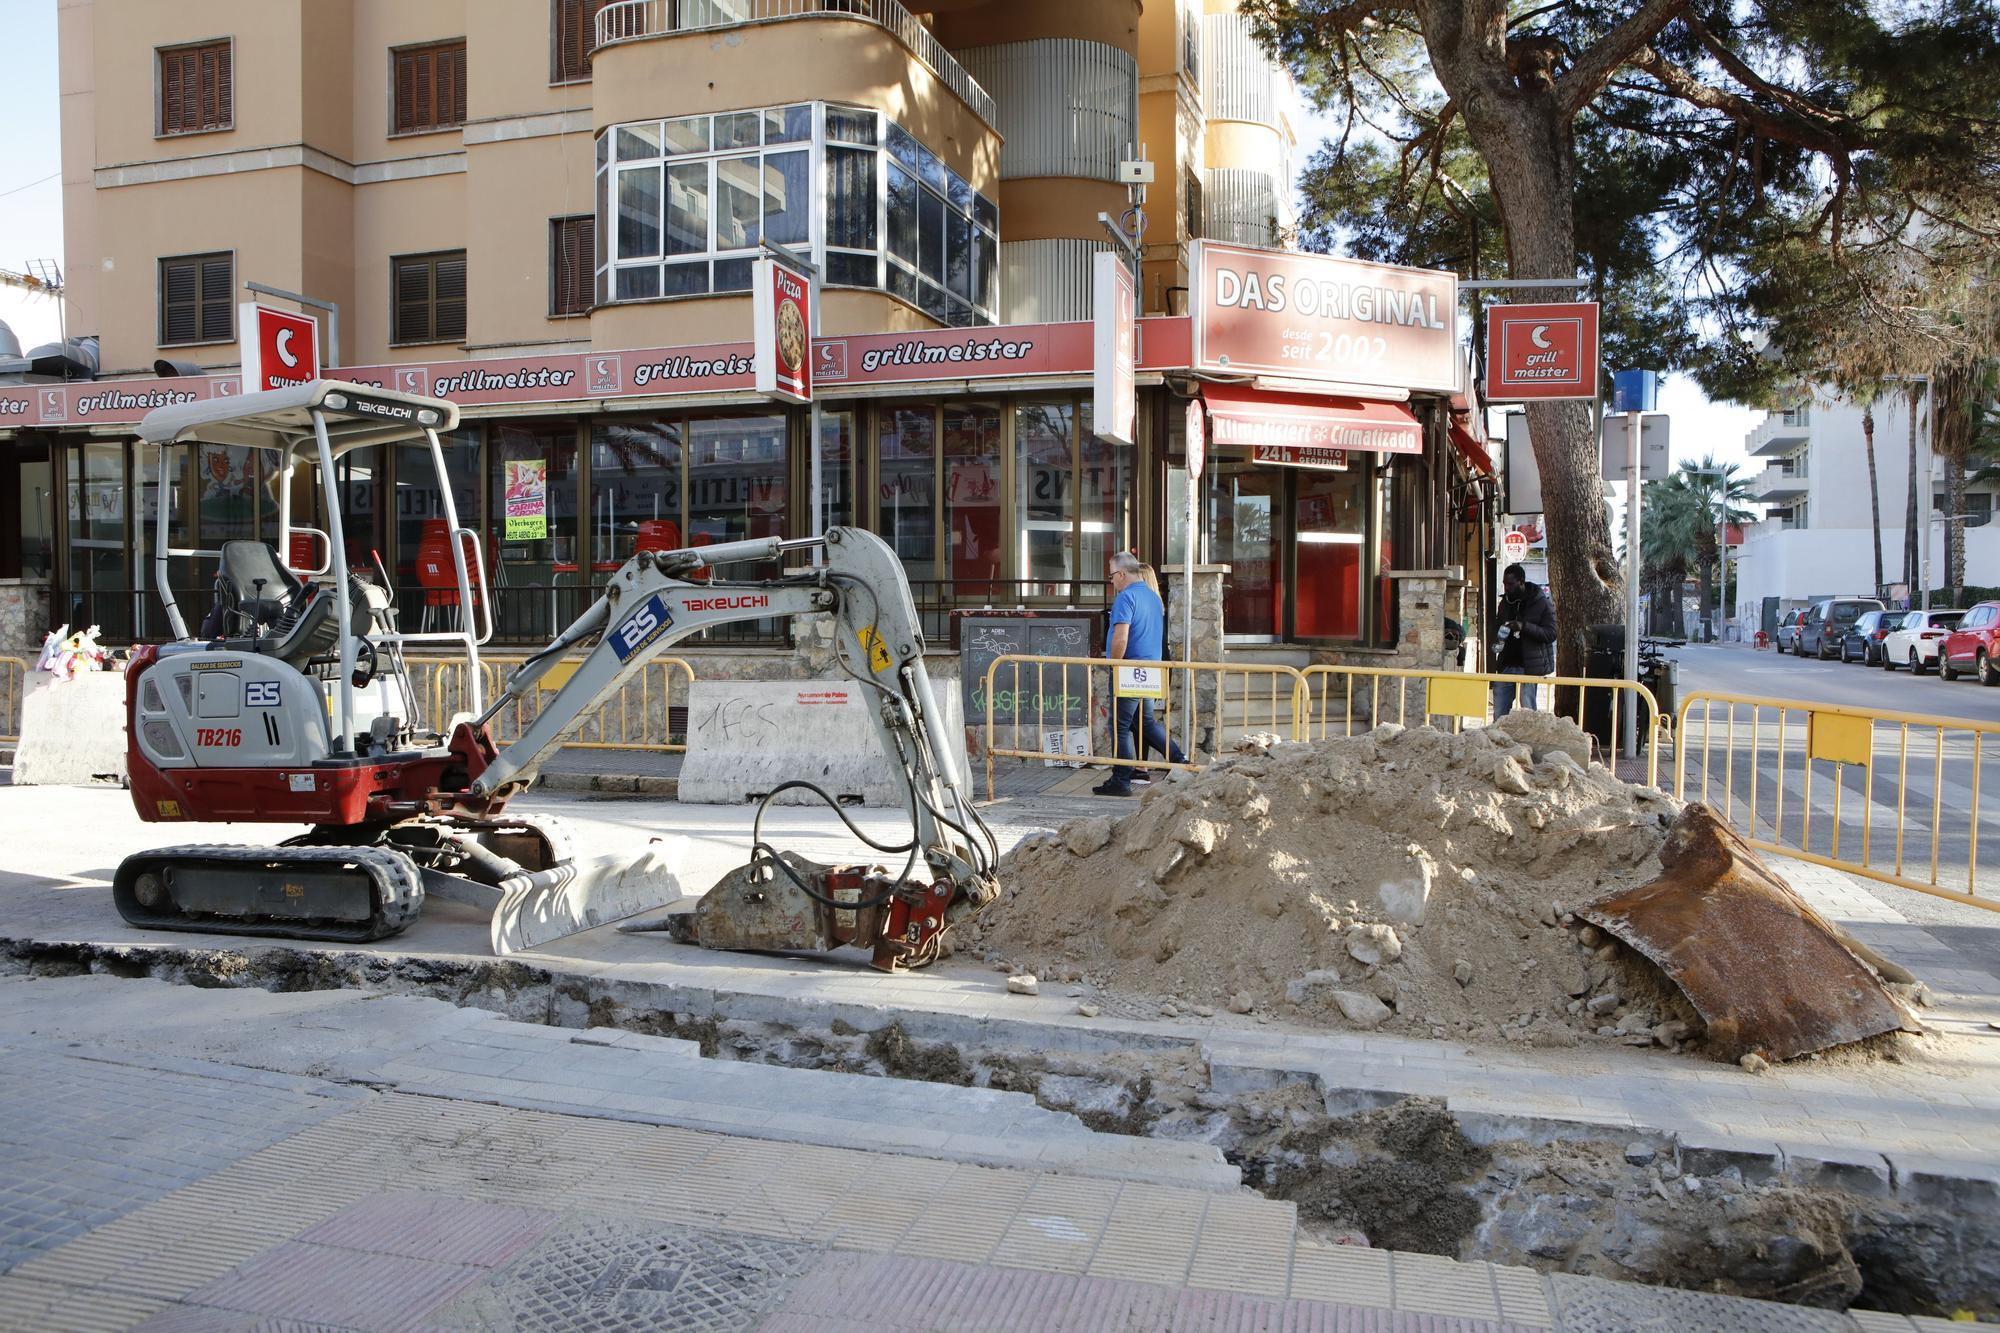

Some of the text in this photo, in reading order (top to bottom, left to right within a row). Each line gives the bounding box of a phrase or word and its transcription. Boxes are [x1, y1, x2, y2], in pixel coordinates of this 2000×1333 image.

[777, 270, 802, 300] Pizza
[1215, 268, 1445, 331] DAS ORIGINAL
[1282, 328, 1313, 340] desde
[862, 339, 1033, 373] grillmeister
[1281, 332, 1387, 367] seit 2002
[1526, 351, 1558, 366] grill
[1514, 366, 1569, 378] meister
[433, 367, 576, 398] grillmeister
[77, 389, 197, 416] grillmeister
[356, 401, 412, 419] TAKEUCHI
[1215, 418, 1416, 449] Klimatisiert Climatizado
[1299, 446, 1342, 458] ABIERTO
[507, 501, 545, 513] CARINA
[682, 595, 769, 612] TAKEUCHI
[620, 605, 658, 649] BS
[217, 661, 242, 669] SERVICIOS
[1133, 667, 1147, 682] BS
[247, 683, 280, 706] BS
[196, 728, 242, 747] TB216
